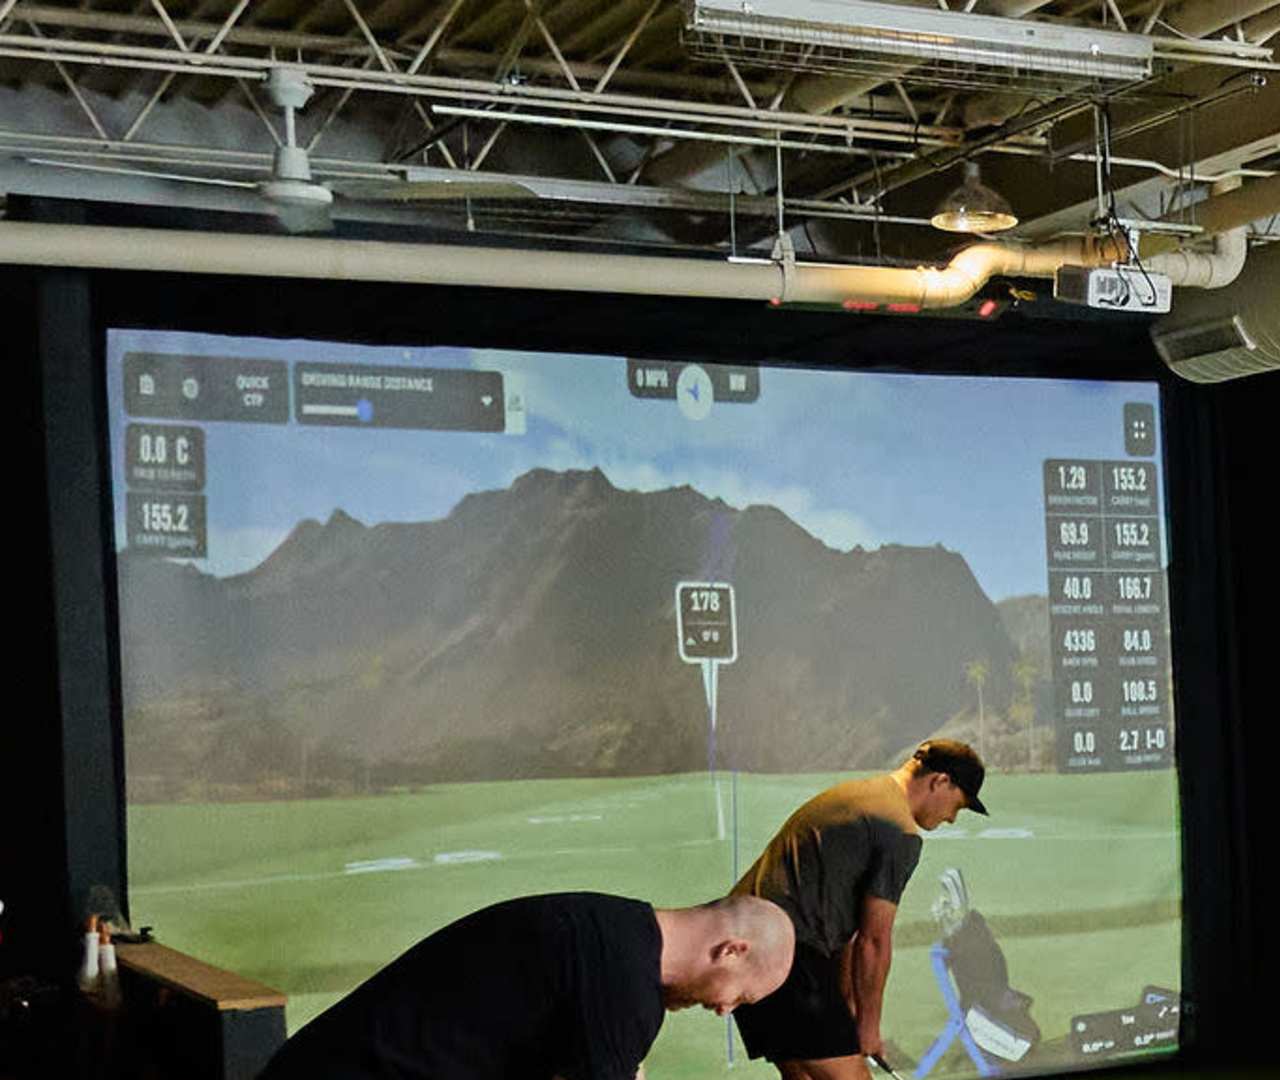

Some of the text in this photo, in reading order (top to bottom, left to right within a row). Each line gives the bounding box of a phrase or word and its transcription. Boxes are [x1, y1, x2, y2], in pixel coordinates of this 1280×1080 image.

[236, 374, 270, 390] QUICK
[384, 376, 433, 392] DISTANCE
[141, 434, 167, 463] 0.0
[1059, 466, 1087, 490] 1.29
[1112, 467, 1147, 491] 155.2
[143, 503, 189, 533] 155.2
[1115, 523, 1150, 546] 155.2
[1063, 576, 1092, 599] 40.0
[690, 591, 720, 612] 178
[1064, 629, 1096, 652] 4336
[1074, 731, 1095, 753] 0.0
[1120, 730, 1139, 752] 2.7
